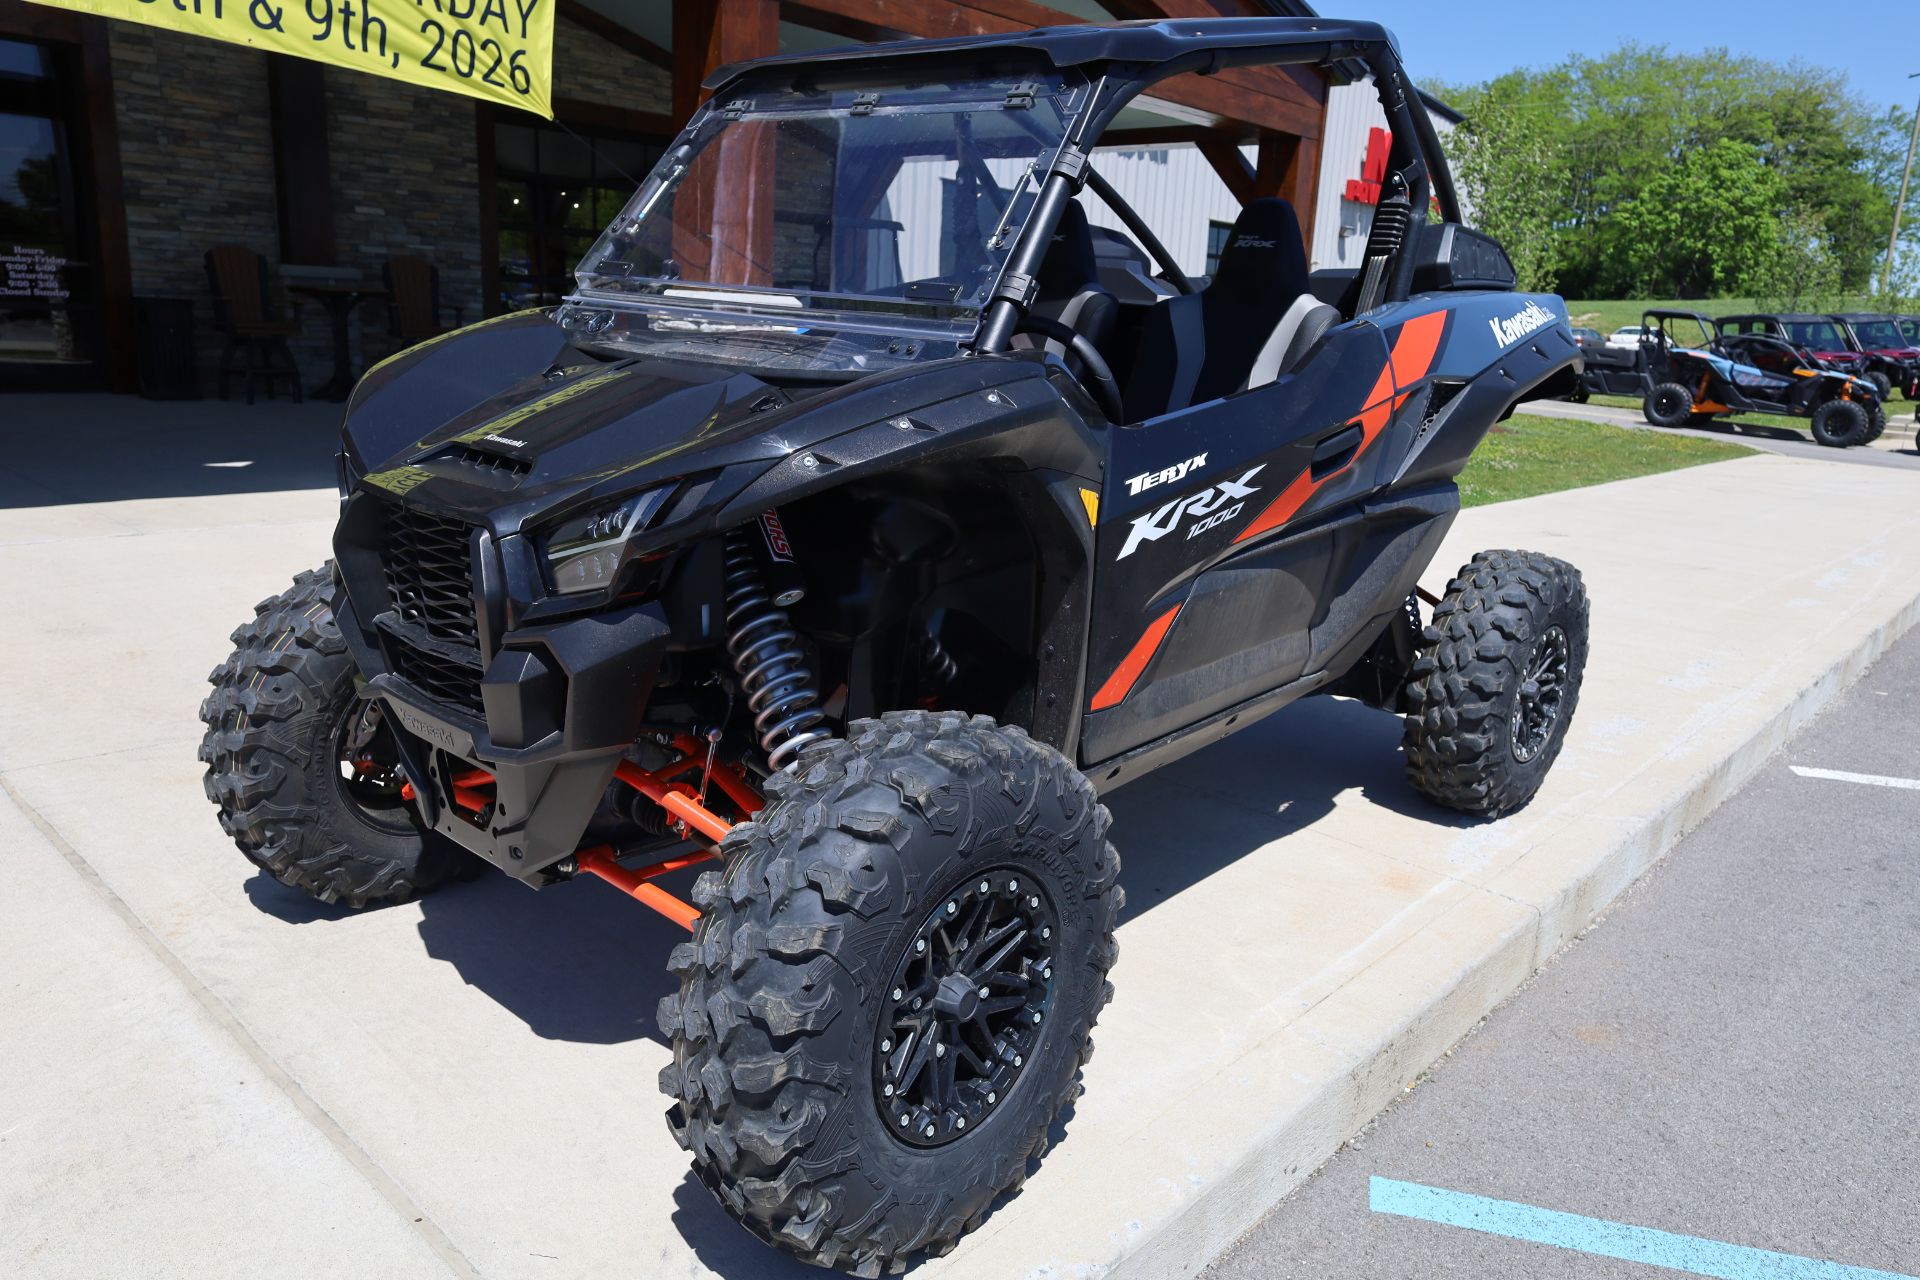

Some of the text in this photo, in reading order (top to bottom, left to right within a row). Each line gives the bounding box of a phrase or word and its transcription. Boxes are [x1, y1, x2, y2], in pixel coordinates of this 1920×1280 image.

[305, 0, 400, 69] 9th,
[420, 19, 531, 95] 2026
[14, 246, 45, 254] Hours
[0, 254, 67, 265] onday-Friday
[9, 271, 55, 280] Saturday
[33, 288, 70, 298] Sunday
[1116, 463, 1268, 561] KRX
[1186, 502, 1245, 541] 1000
